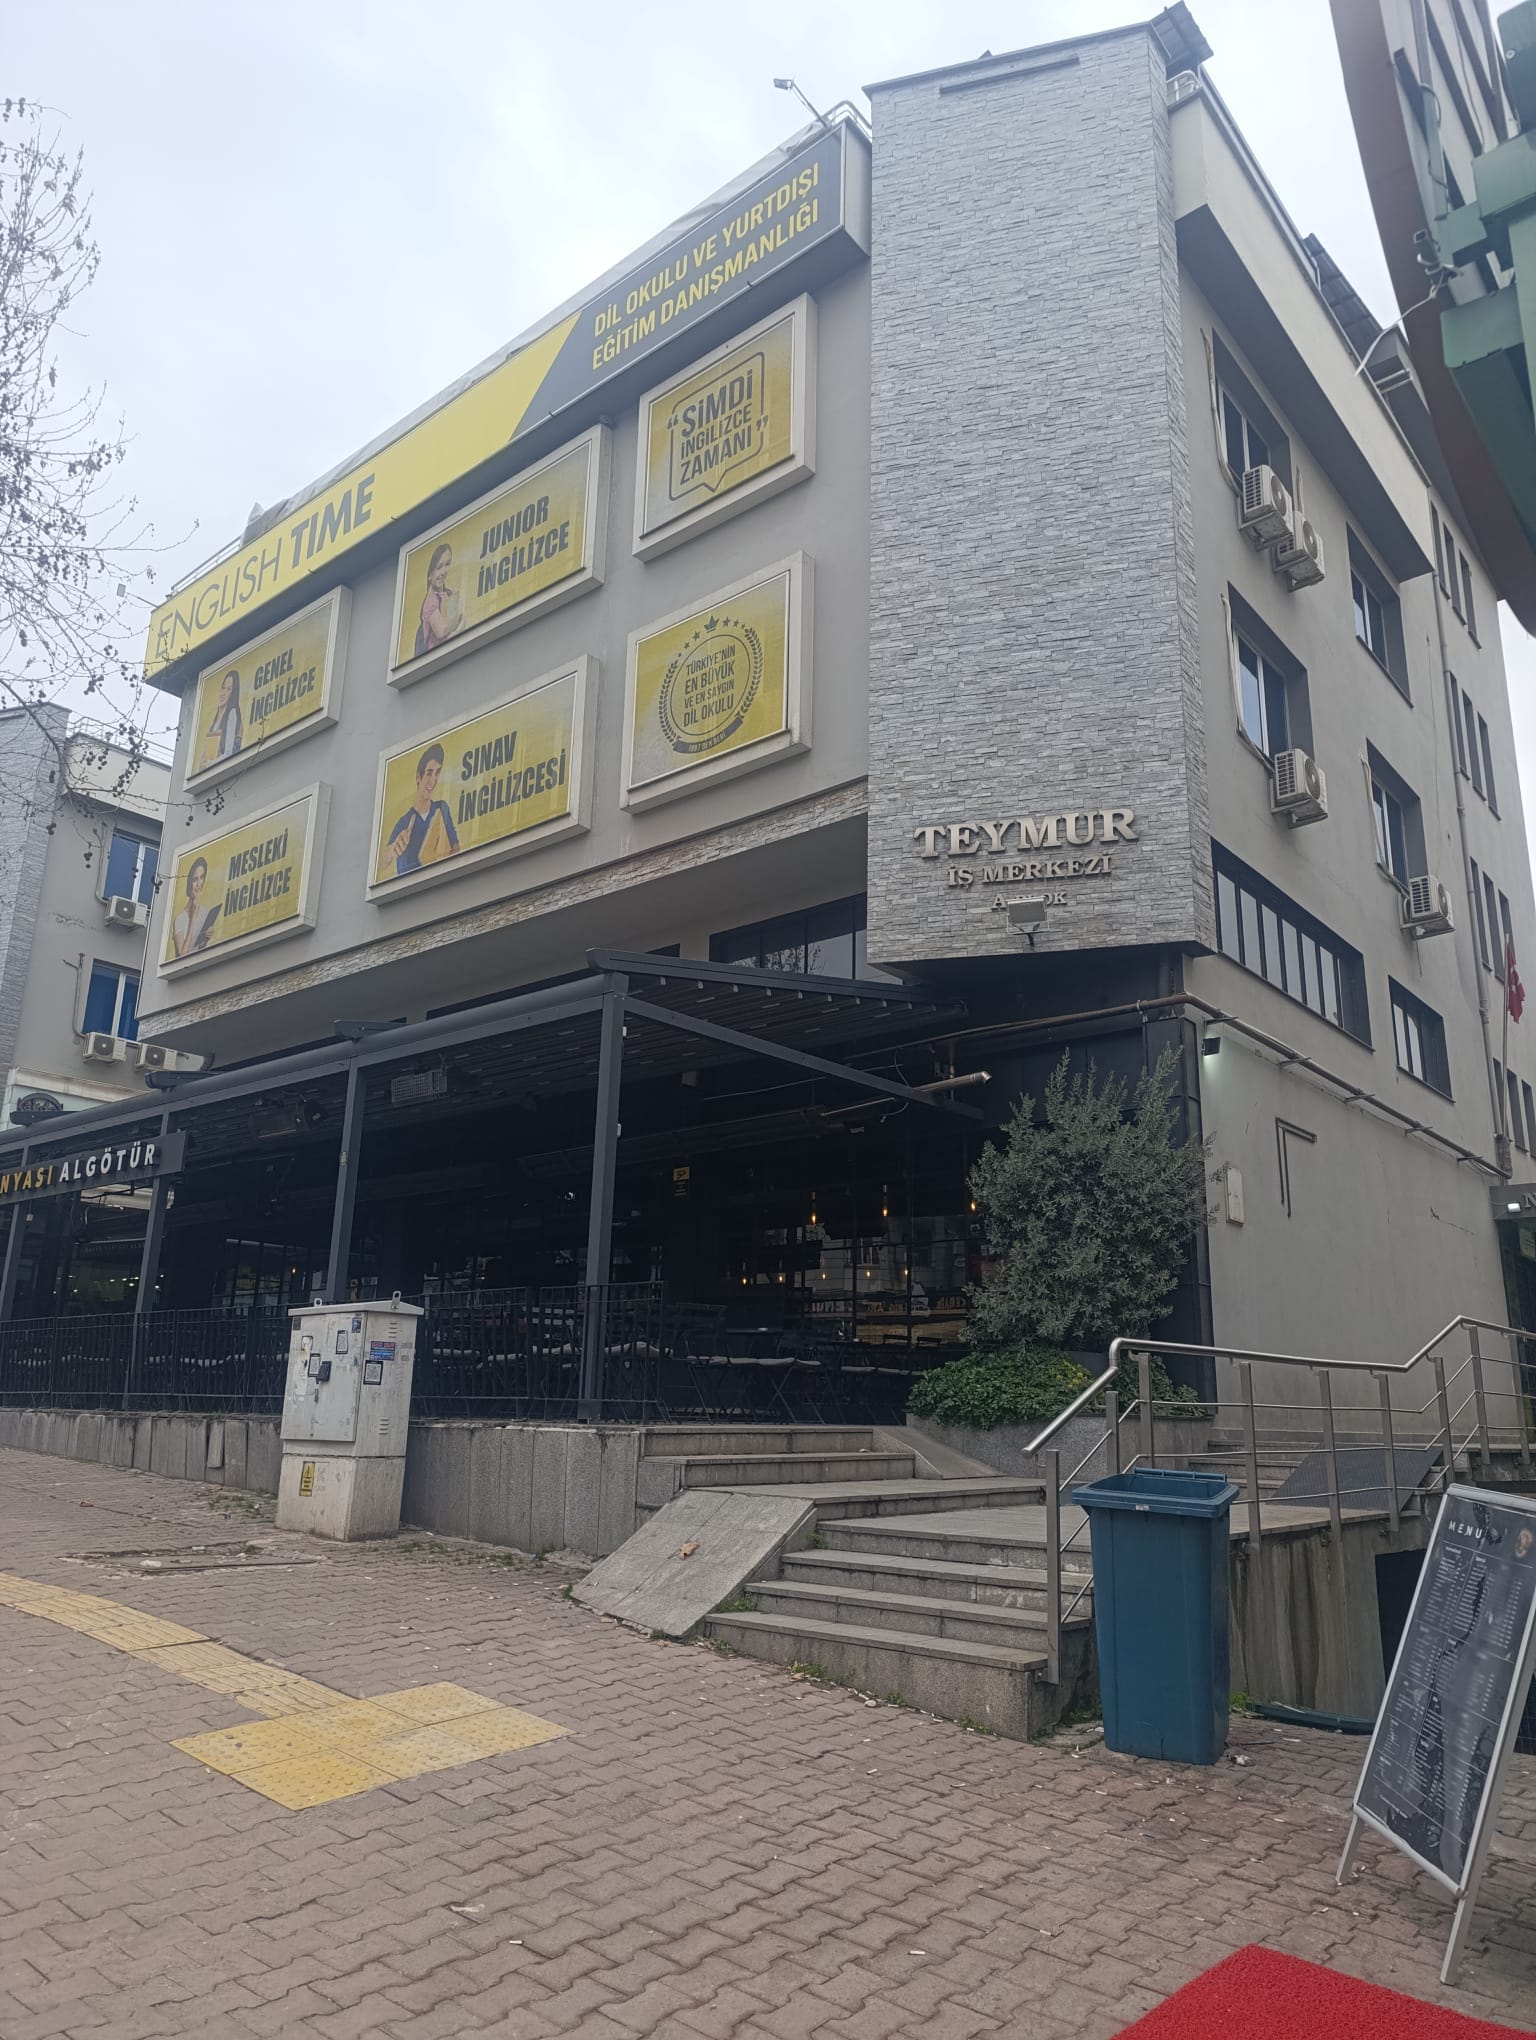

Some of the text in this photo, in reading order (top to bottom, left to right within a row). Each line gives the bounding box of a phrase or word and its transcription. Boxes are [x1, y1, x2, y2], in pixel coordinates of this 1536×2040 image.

[594, 162, 819, 337] DİL OKULU VE YURTDIŞI
[593, 198, 819, 370] EĞİTİM DANIŞMANLIĞI
[681, 402, 753, 460] İNGİLİZCE
[480, 495, 549, 560] JUNIOR
[155, 472, 376, 659] ENGLISH TIME
[477, 520, 570, 598] İNGİLİZCE
[254, 648, 293, 691] GENEL
[685, 660, 735, 695] EN BÜYÜK
[685, 679, 735, 709] VE EN SAYGIN
[249, 666, 316, 725] İNGİLİZCE
[683, 693, 734, 727] DİL OKULU
[461, 731, 517, 781] SINAV
[458, 748, 566, 825] İNGİLİZCESİ
[228, 827, 289, 881] MESLEKİ
[914, 808, 1139, 860] TEYMUR
[223, 867, 292, 918] İNGİLİZCE
[948, 851, 1112, 889] İŞ MERKEZİ
[991, 893, 1007, 912] A
[59, 1141, 155, 1183] ALGÖTÜR
[1448, 1520, 1483, 1539] MENU
